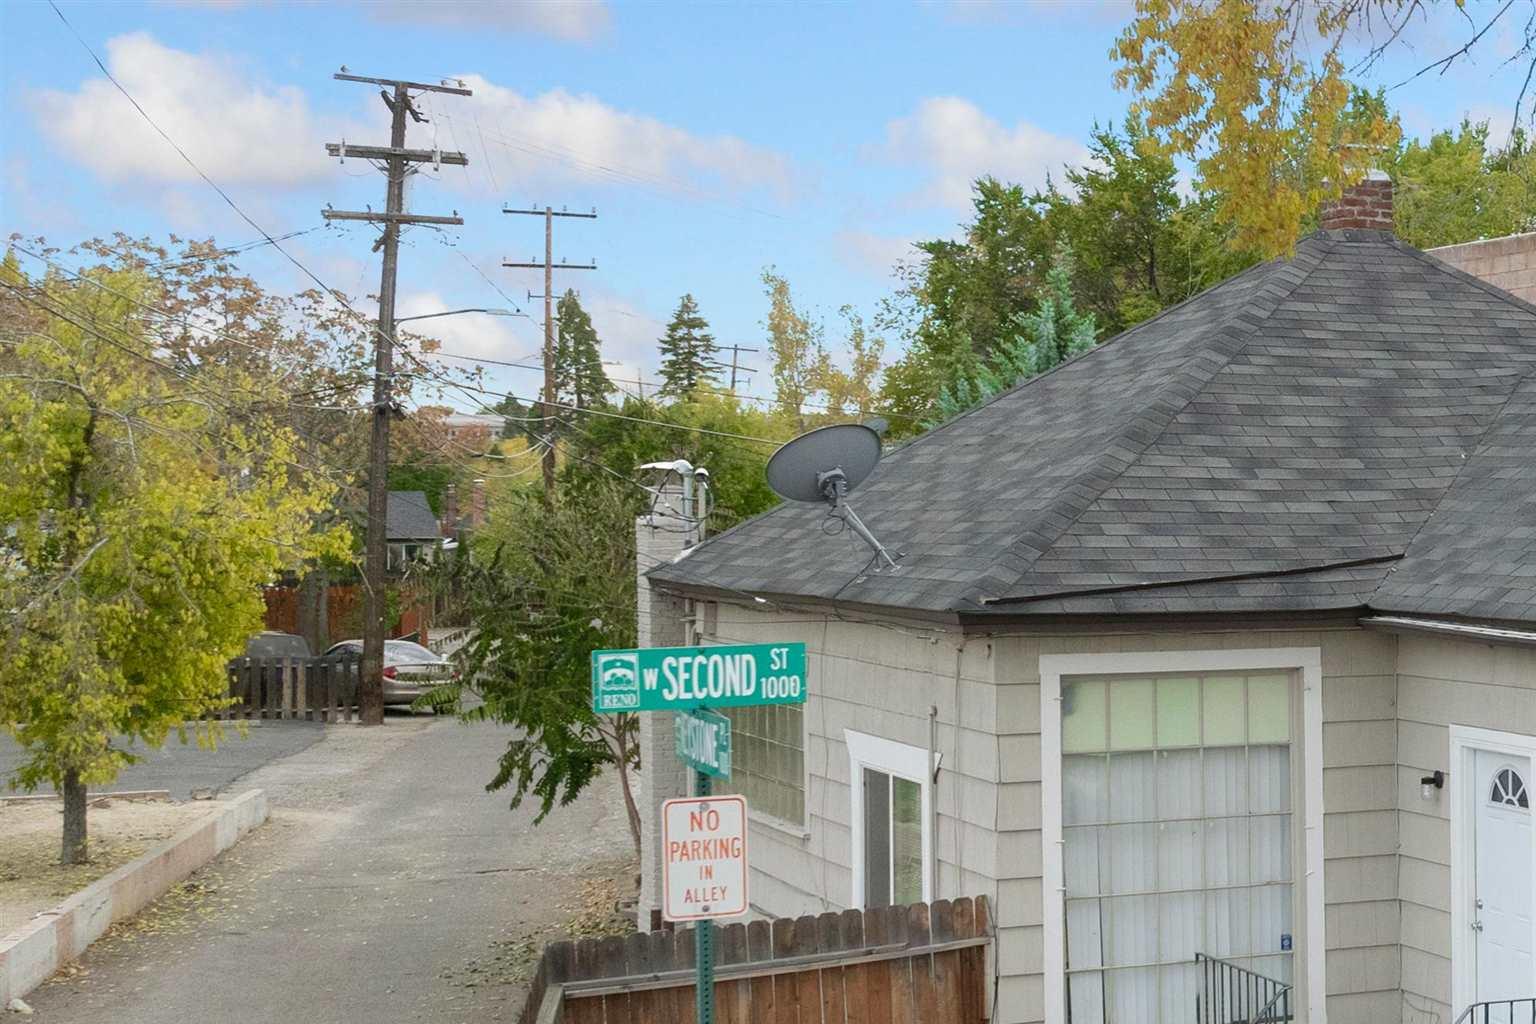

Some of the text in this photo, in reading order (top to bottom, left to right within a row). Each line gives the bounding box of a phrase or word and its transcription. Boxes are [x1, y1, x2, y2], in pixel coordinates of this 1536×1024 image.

[643, 648, 789, 700] W SECOND ST
[760, 675, 801, 699] 1000
[603, 693, 637, 707] RENO
[690, 809, 720, 832] NO
[670, 837, 741, 862] PARKING
[699, 865, 713, 881] IN
[684, 885, 728, 904] ALLEY
